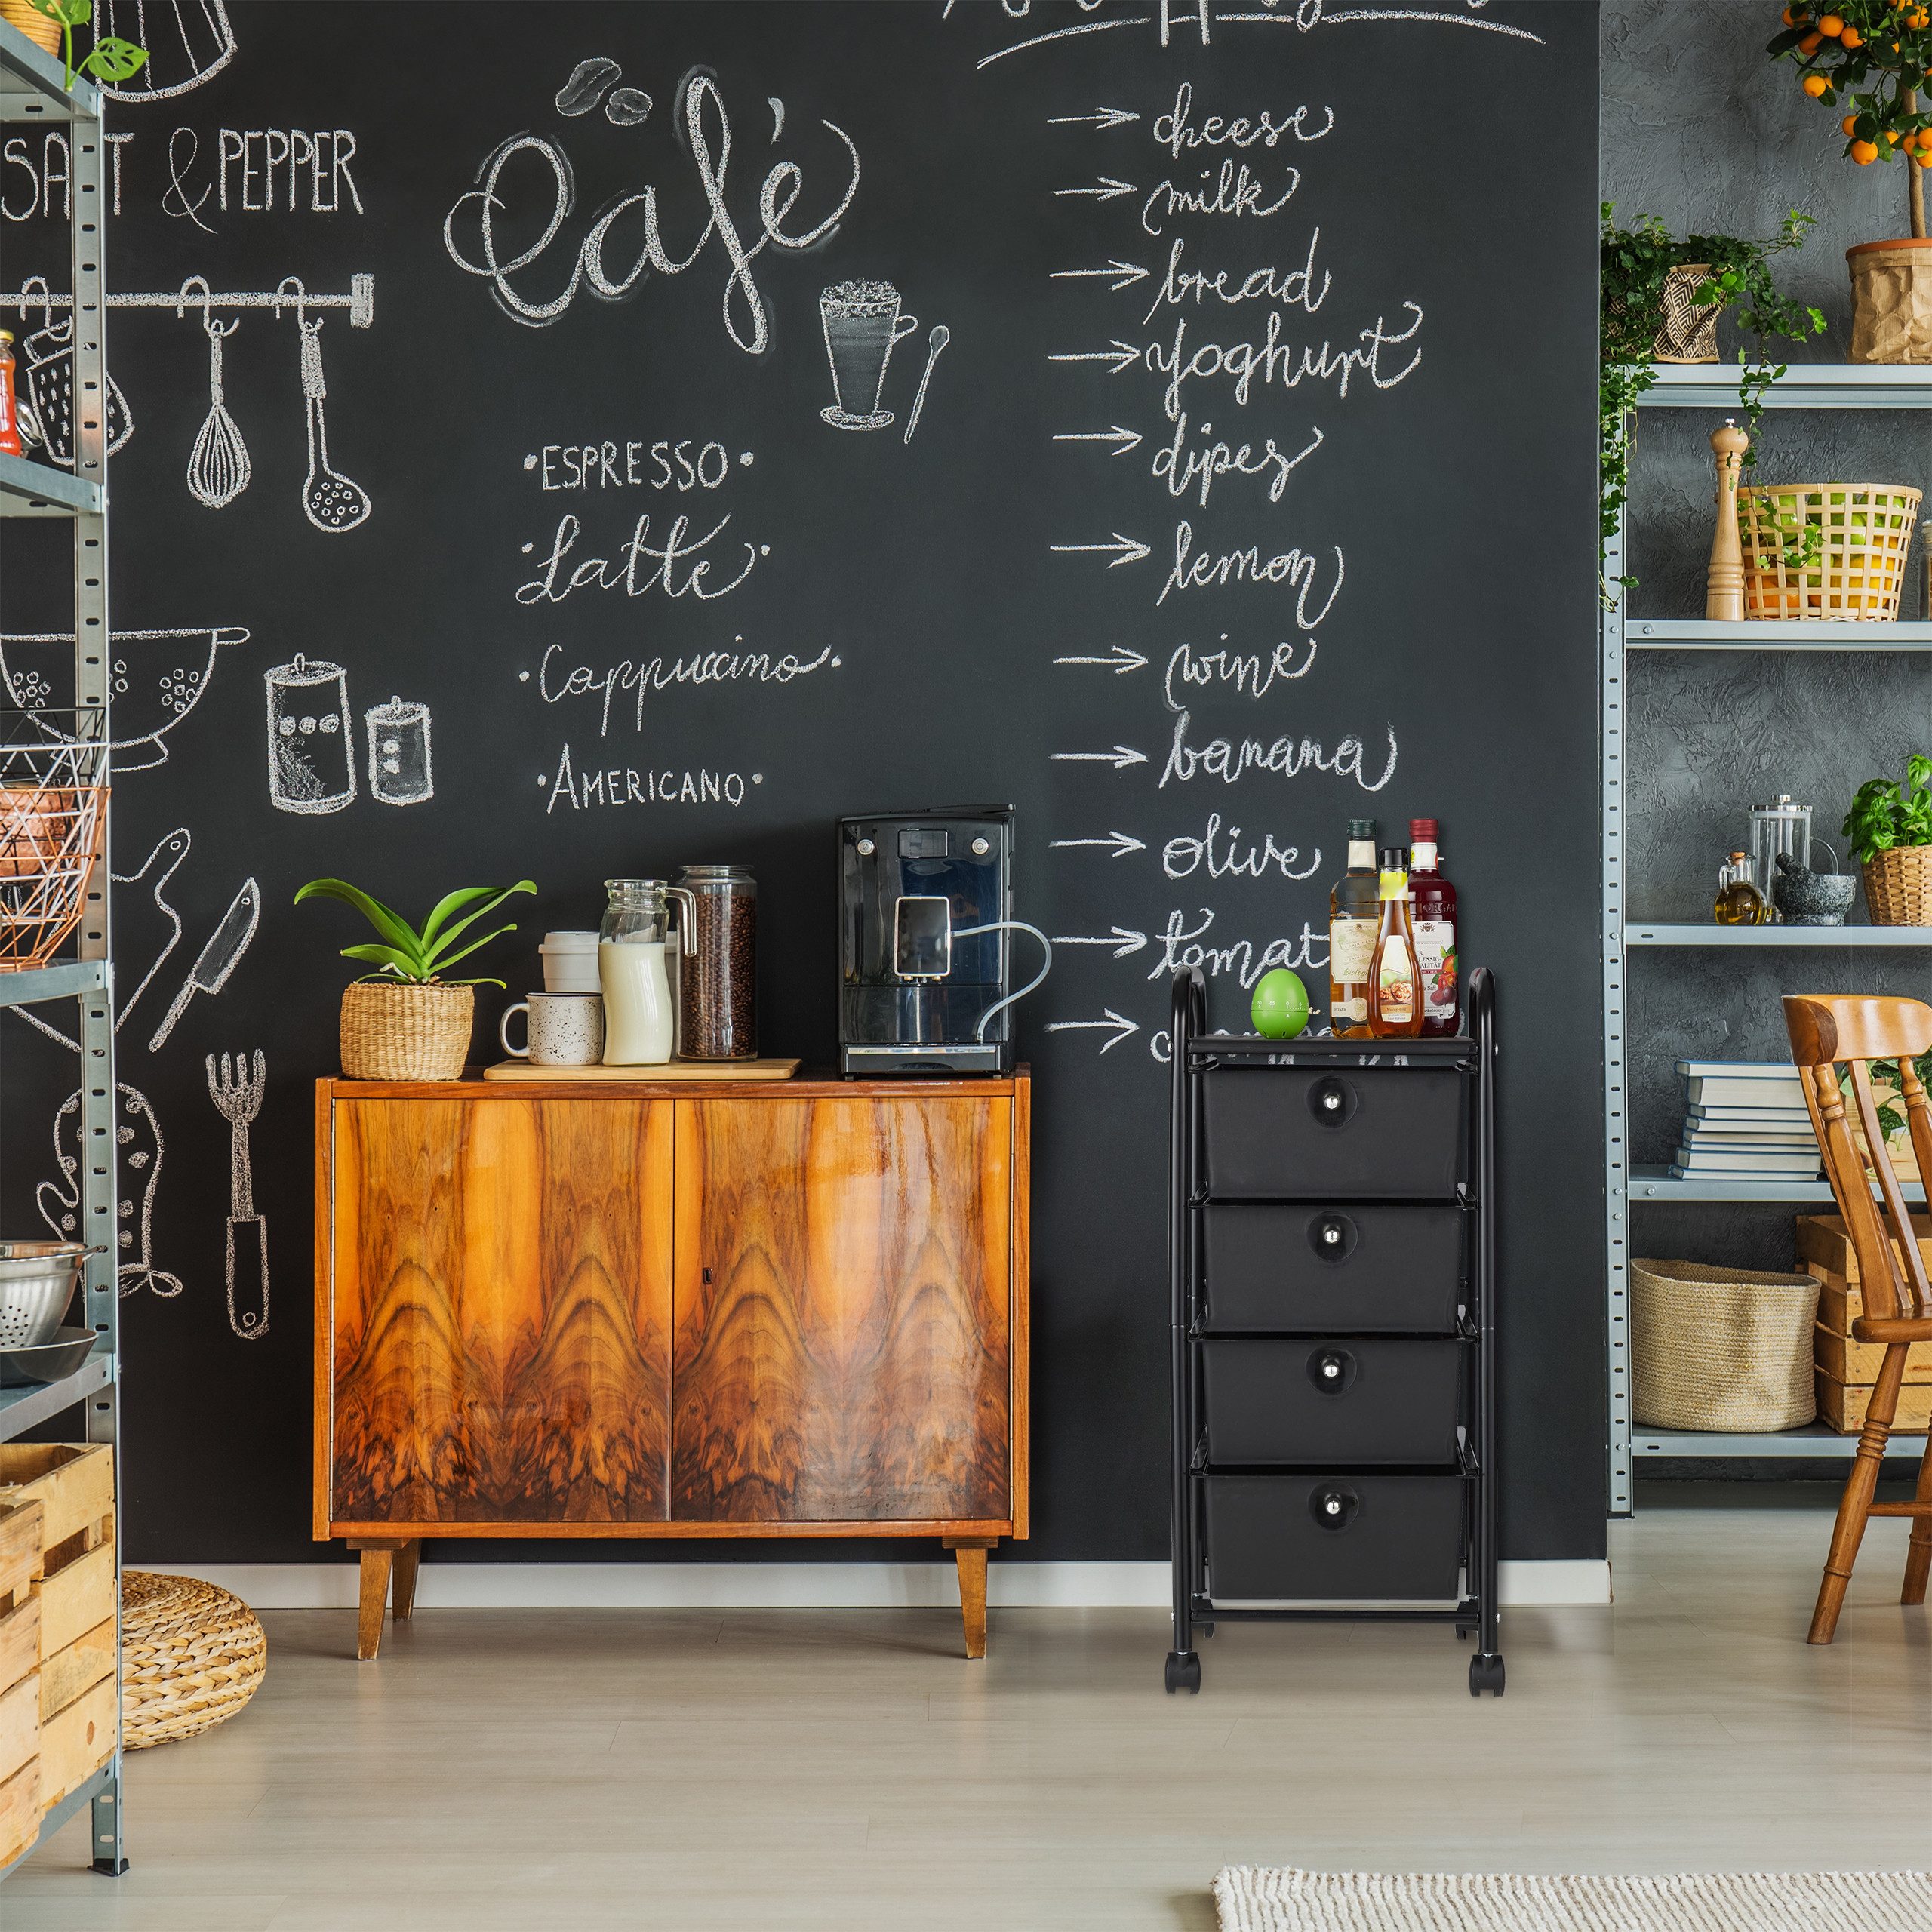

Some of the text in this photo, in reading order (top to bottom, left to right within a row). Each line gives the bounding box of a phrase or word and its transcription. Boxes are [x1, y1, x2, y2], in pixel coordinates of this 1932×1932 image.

[1153, 82, 1334, 158] cheese
[1, 127, 365, 234] SAT & PEPPER
[444, 76, 860, 355] Café
[1142, 158, 1300, 235] milk
[1143, 226, 1332, 325] bread
[1145, 301, 1423, 421] yoghurt
[542, 440, 728, 492] ESPRESSO
[515, 512, 755, 605] Latte
[1155, 520, 1346, 630] lemon
[539, 634, 832, 737] Cappuccino
[1164, 633, 1318, 711] wine
[546, 743, 746, 815] AMERICANO
[1158, 710, 1398, 792] banana
[1162, 812, 1322, 881] olive
[1147, 907, 1331, 989] tomat
